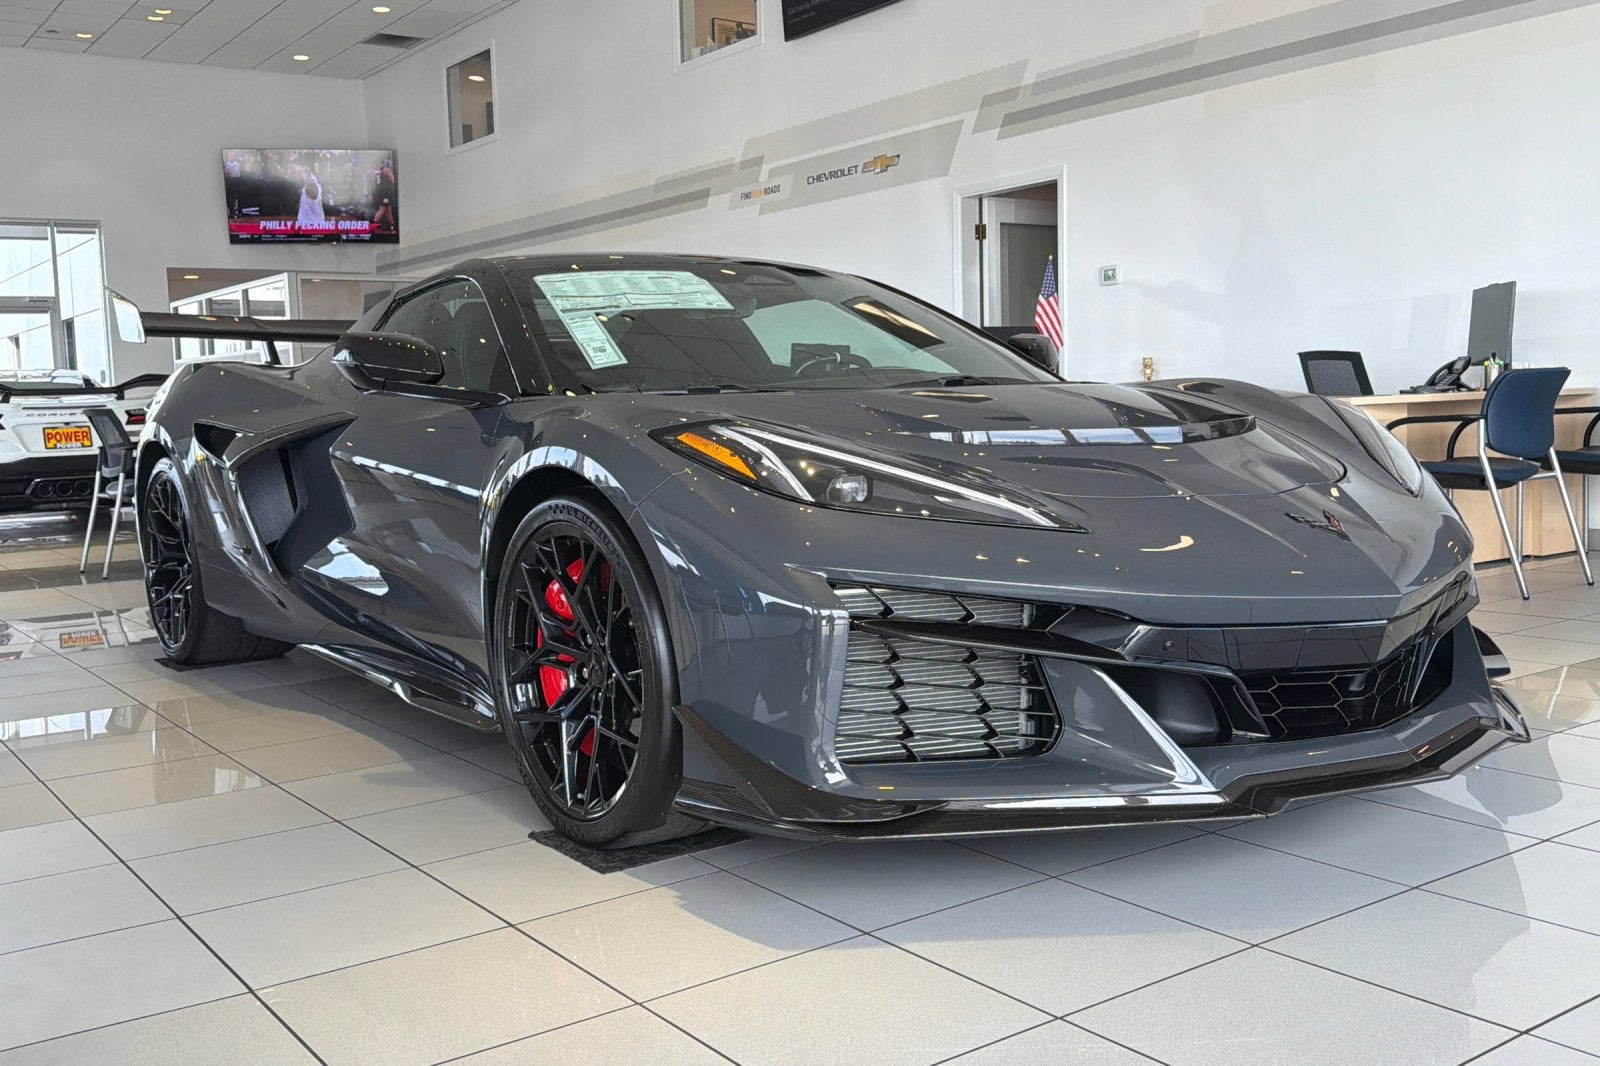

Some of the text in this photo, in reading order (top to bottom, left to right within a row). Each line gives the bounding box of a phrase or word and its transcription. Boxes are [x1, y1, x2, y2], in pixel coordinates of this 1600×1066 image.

[806, 165, 859, 185] CHEVROLET
[740, 185, 780, 201] FIND NEW ROADS
[259, 220, 370, 230] PHILLY PECKING ORDER
[46, 430, 90, 443] POWER
